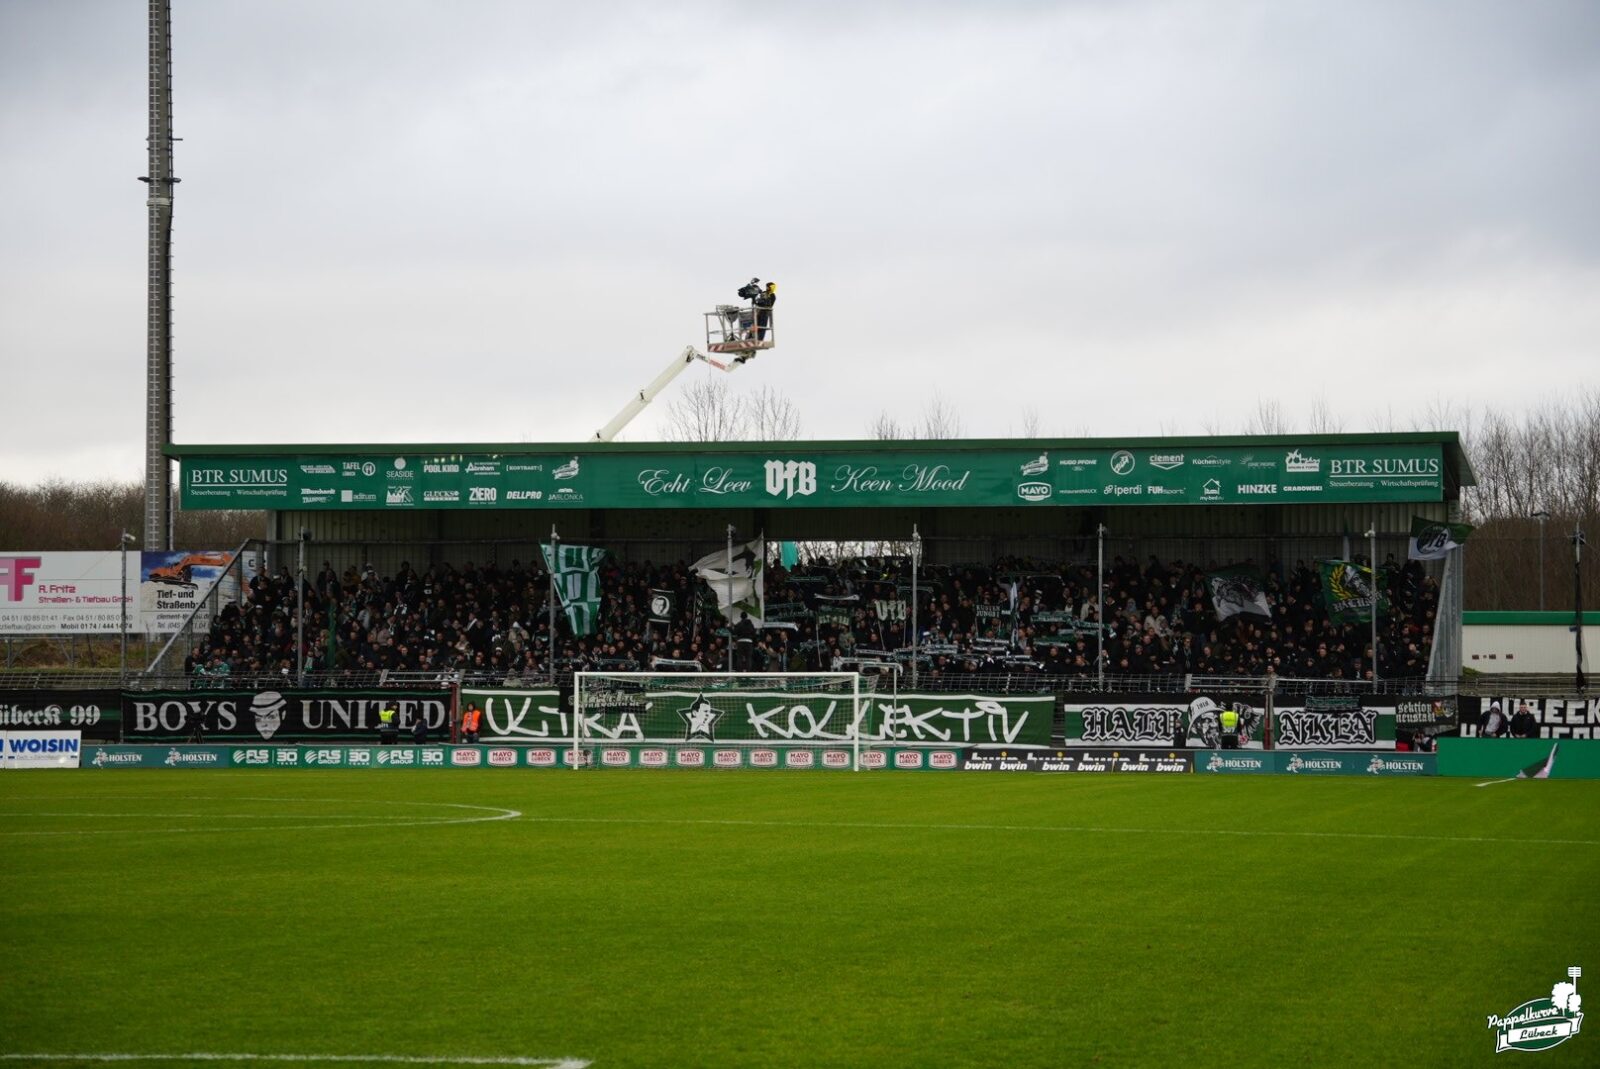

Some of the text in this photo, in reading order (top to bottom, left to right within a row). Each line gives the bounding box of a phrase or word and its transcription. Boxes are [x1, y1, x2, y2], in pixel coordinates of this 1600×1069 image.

[1149, 454, 1184, 462] clement
[1330, 458, 1439, 474] BTR SUMUS
[191, 469, 288, 483] BTR SUMUS
[386, 470, 414, 478] SEASIDE
[831, 463, 970, 493] Keen Mood
[637, 469, 690, 496] Echt
[1021, 486, 1048, 494] MAYO
[1237, 484, 1277, 494] HINZKE
[506, 490, 542, 500] DELLPRO
[157, 590, 194, 598] Tief- und
[70, 704, 101, 726] 99
[133, 699, 446, 731] BOYS UNITED
[9, 738, 78, 753] WOISIN
[246, 750, 268, 759] FLS
[277, 752, 298, 761] 30
[318, 750, 341, 759] FLS
[348, 752, 370, 762] 30
[390, 750, 413, 759] FLS
[422, 752, 443, 762] 30
[964, 760, 992, 770] bwin
[1000, 760, 1027, 770] bwin
[1042, 761, 1070, 771] bwin
[1077, 761, 1105, 771] bwin
[1121, 761, 1149, 771] bwin
[1156, 761, 1184, 772] bwin
[1225, 760, 1262, 768] HOLSTEN
[1385, 762, 1424, 770] HOLSTEN
